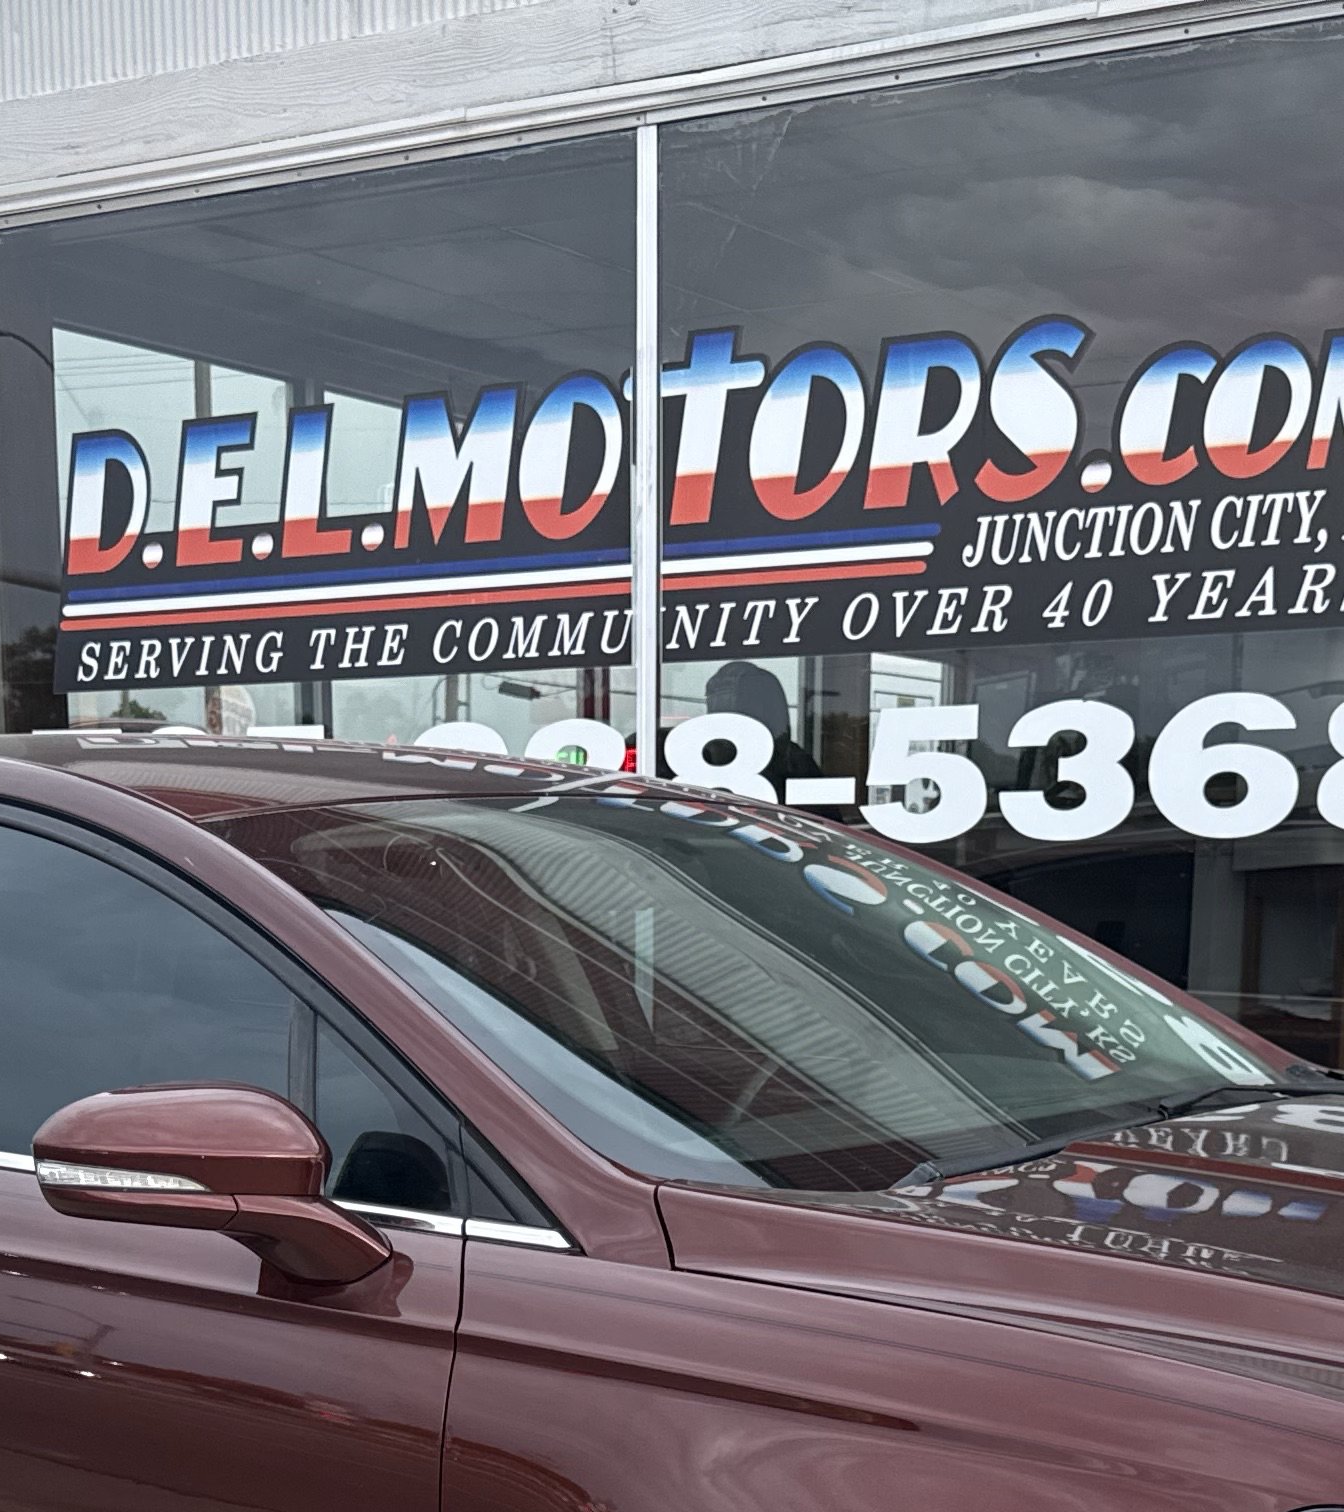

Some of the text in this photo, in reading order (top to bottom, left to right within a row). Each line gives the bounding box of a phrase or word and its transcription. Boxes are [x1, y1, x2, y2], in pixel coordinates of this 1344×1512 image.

[962, 499, 1201, 568] JUNCTION
[1209, 489, 1331, 551] CITY,
[76, 631, 285, 683] SERVING
[309, 622, 409, 669] THE
[432, 595, 820, 663] COMMUNITY
[842, 583, 1012, 641] OVER
[1043, 579, 1115, 630] 40
